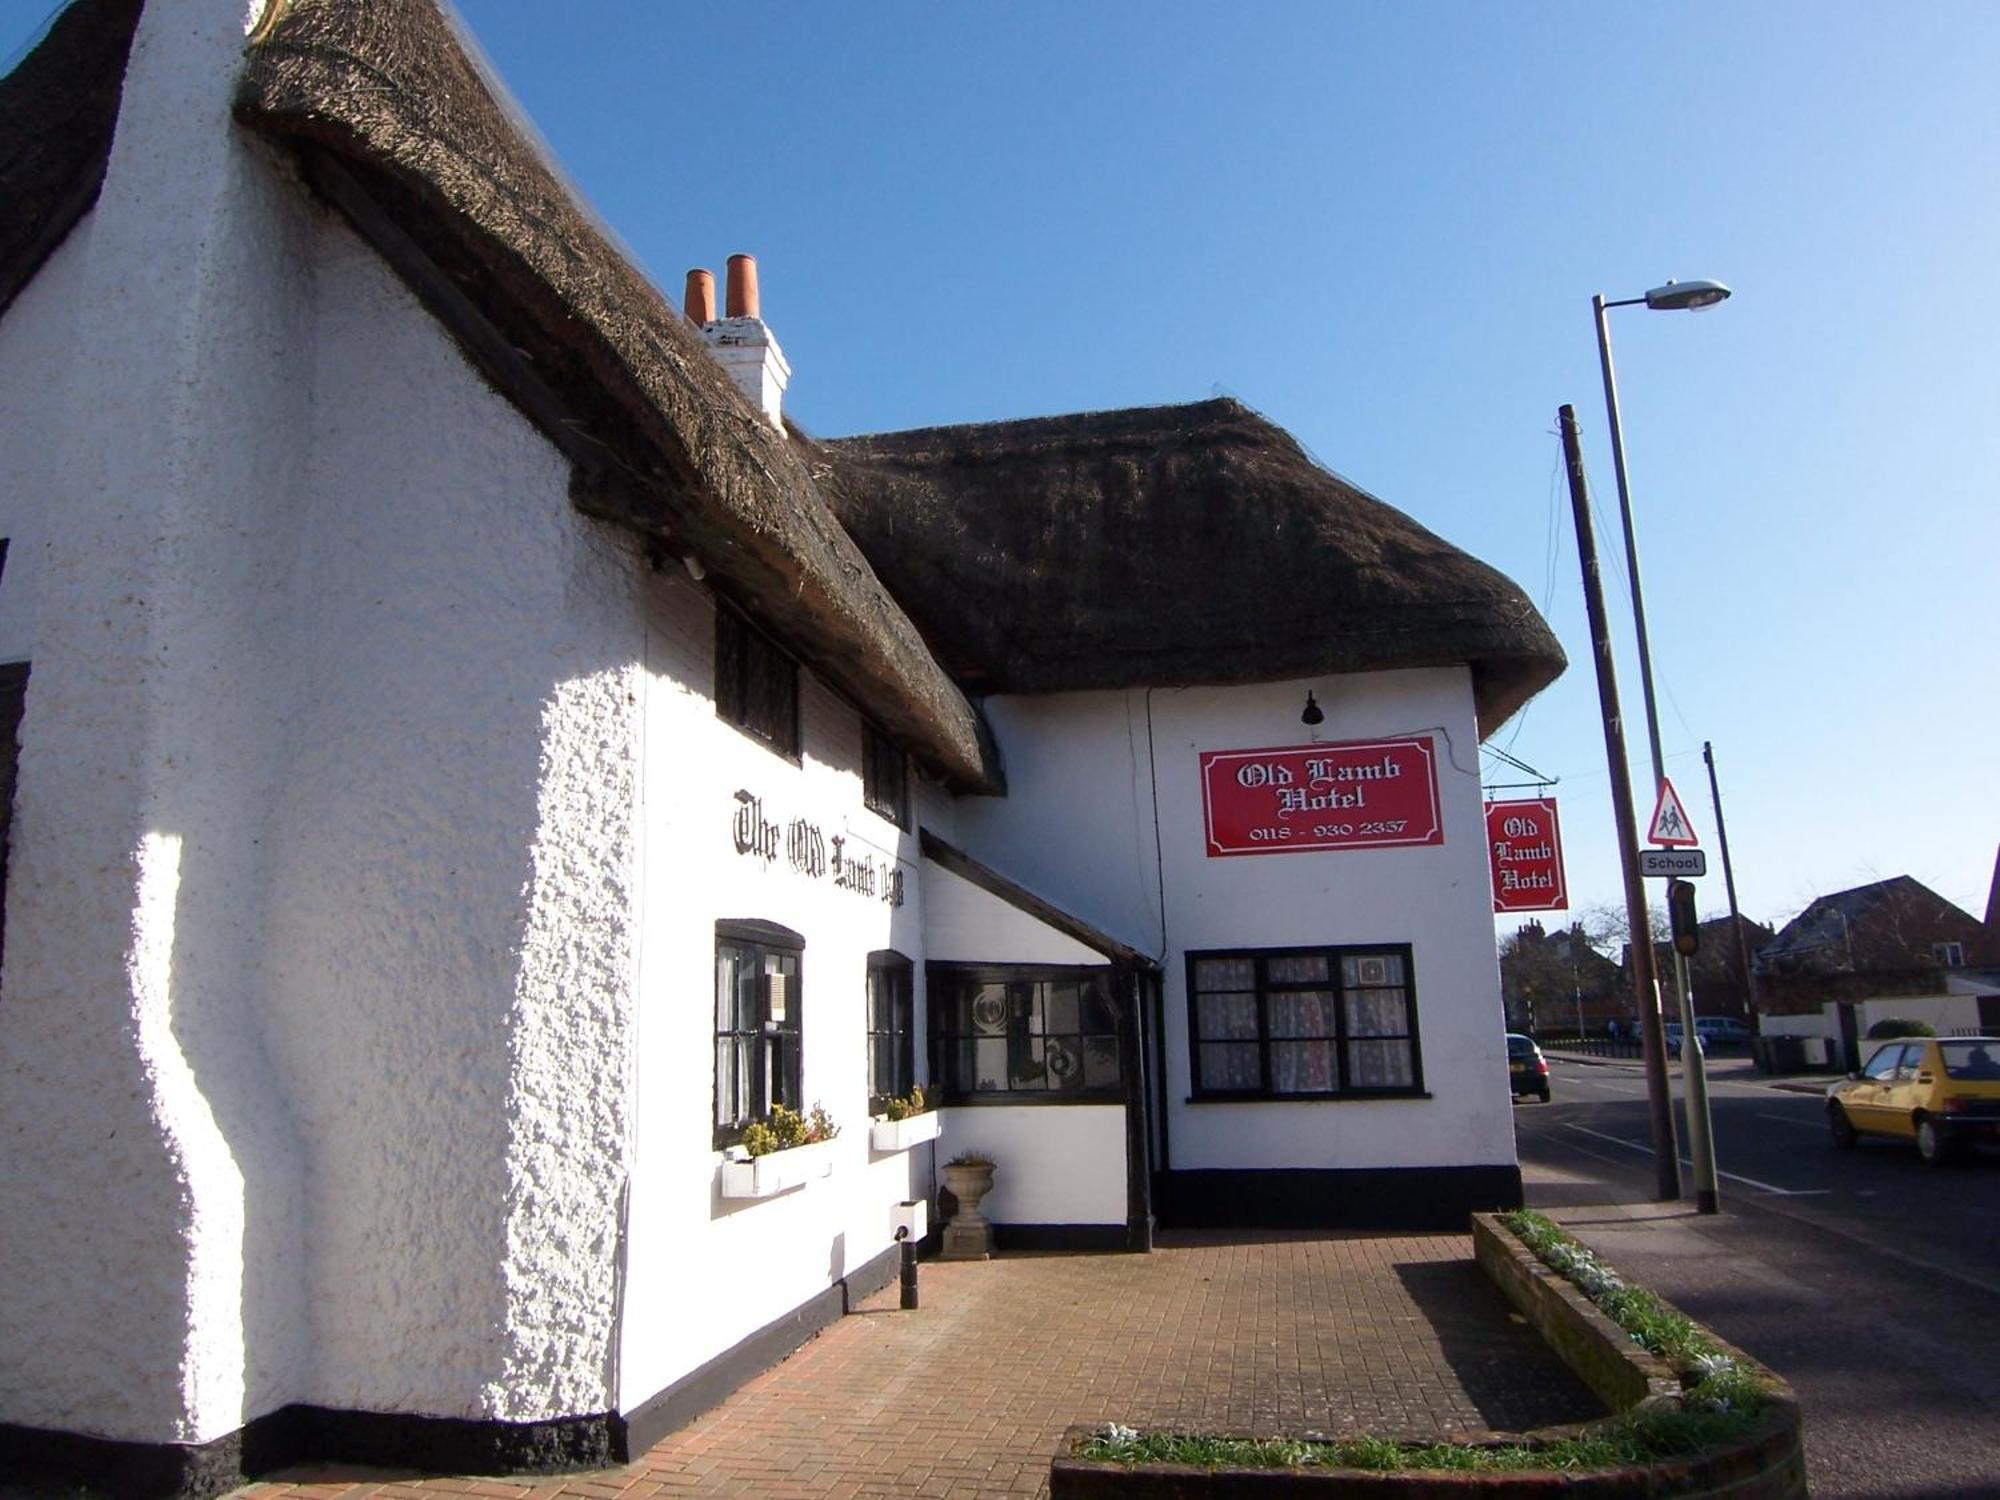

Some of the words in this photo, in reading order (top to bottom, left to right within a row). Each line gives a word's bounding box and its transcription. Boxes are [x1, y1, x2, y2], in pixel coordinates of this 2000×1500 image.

[1237, 762, 1293, 787] Old
[1306, 756, 1400, 790] Lamb
[1276, 785, 1366, 820] Hotel
[1249, 826, 1292, 841] 0118
[1313, 823, 1353, 837] 930
[1503, 817, 1538, 838] Old
[733, 788, 780, 864] The
[787, 816, 826, 879] Old
[831, 835, 876, 897] Lamb
[1495, 841, 1552, 868] Lamb
[1647, 857, 1699, 870] School
[1501, 869, 1554, 896] Hotel
